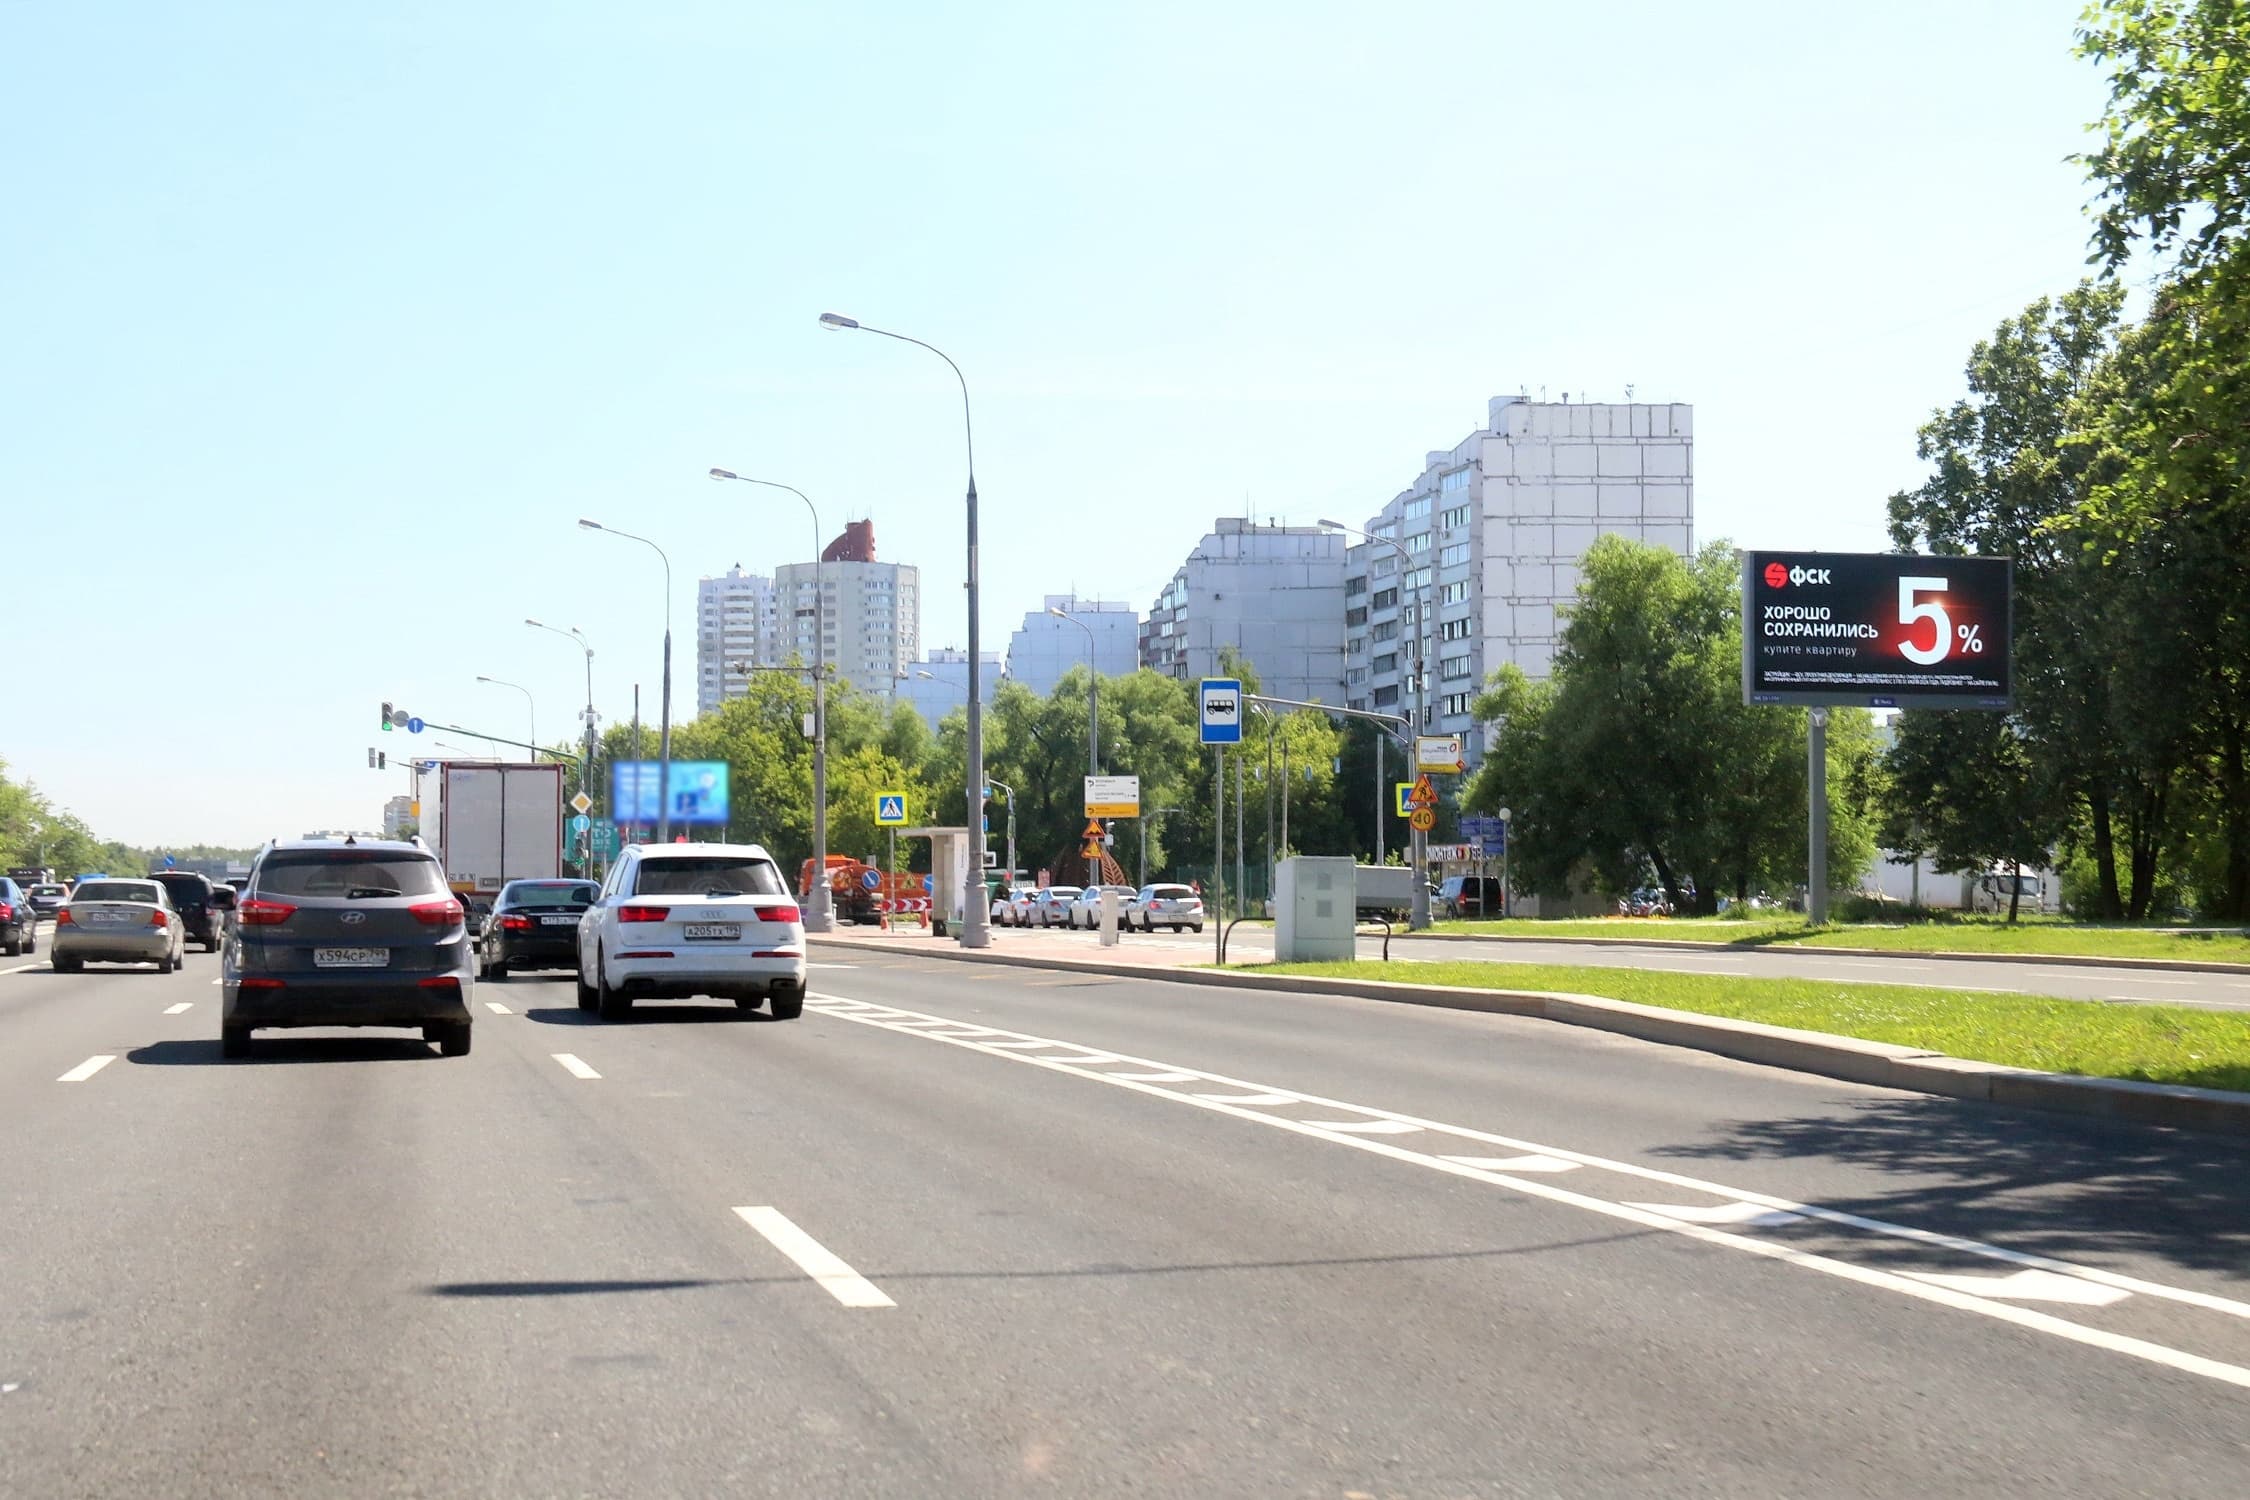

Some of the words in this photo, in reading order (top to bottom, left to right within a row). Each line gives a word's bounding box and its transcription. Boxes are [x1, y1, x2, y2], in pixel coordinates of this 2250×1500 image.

[1789, 565, 1831, 587] ФСК
[1764, 605, 1831, 620] ХОРОШО
[1764, 622, 1879, 638] СОХРАНИЛИСЬ
[1763, 645, 1802, 657] купите
[1805, 646, 1858, 658] квартиру
[1413, 813, 1431, 825] 40
